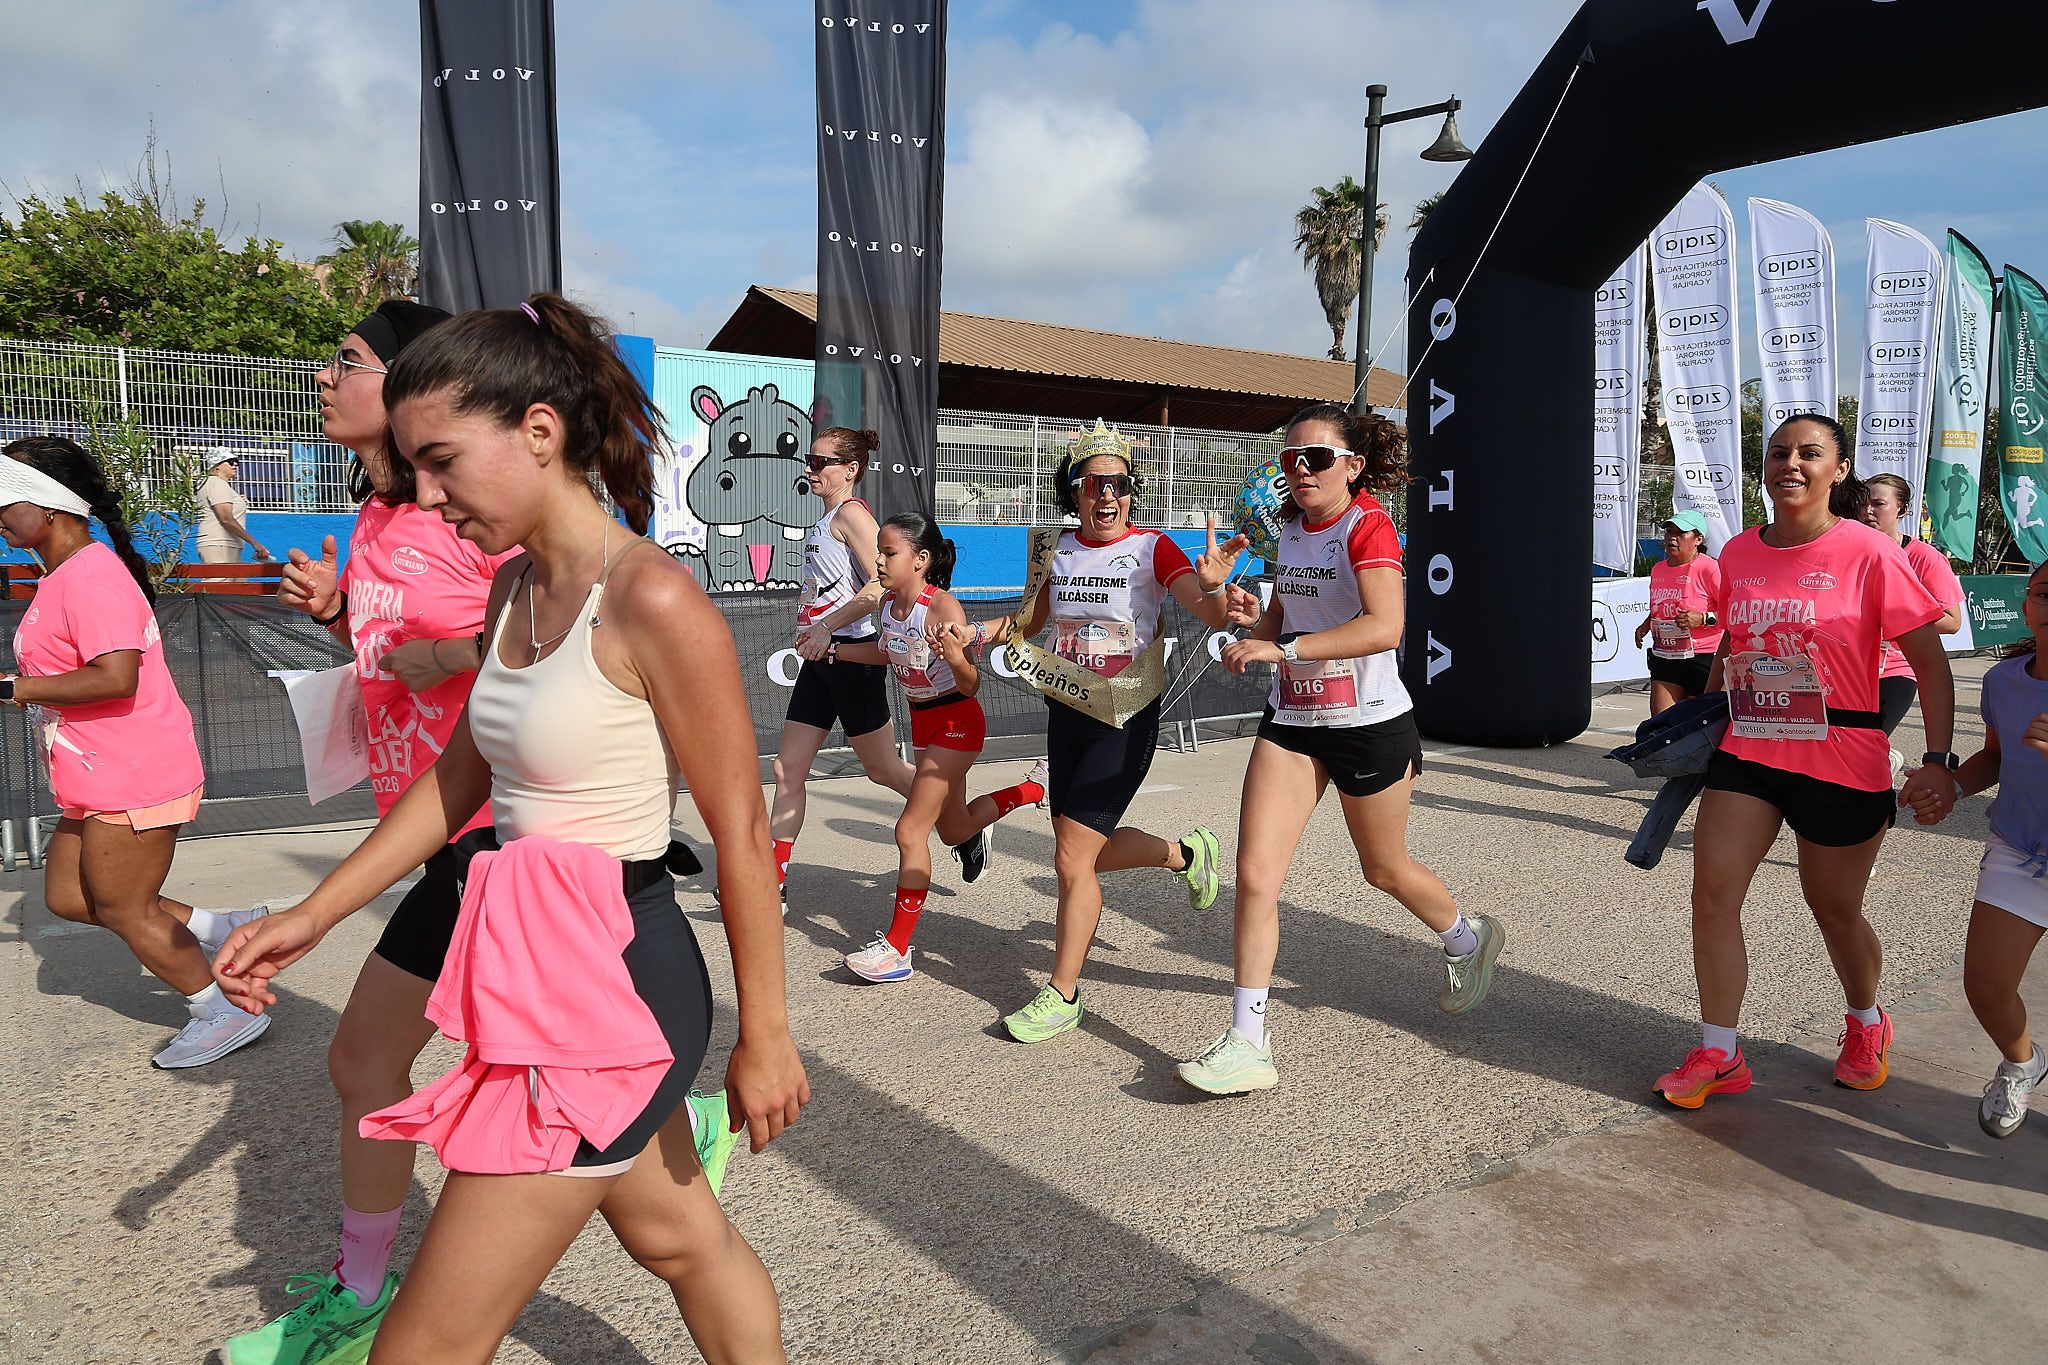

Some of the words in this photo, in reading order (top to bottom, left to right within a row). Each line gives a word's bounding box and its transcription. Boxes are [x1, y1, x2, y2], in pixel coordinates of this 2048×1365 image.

[1425, 297, 1457, 686] VOLVO
[1286, 566, 1337, 580] ATLETISME
[1069, 577, 1128, 589] ATLETISME
[1732, 576, 1767, 590] OYSHO
[1056, 589, 1109, 604] ALCÀSSER
[1616, 602, 1650, 614] COSMÉTIC
[1729, 598, 1817, 625] CARRERA
[1077, 653, 1106, 667] 016
[892, 664, 910, 677] 016
[1754, 663, 1790, 672] ASTURIANA
[1293, 679, 1325, 694] 016
[1755, 691, 1791, 706] 016
[365, 704, 401, 745] LA
[1320, 713, 1349, 722] Santander
[1740, 725, 1766, 734] OYSHO
[370, 739, 412, 778] JER
[373, 774, 399, 793] 026
